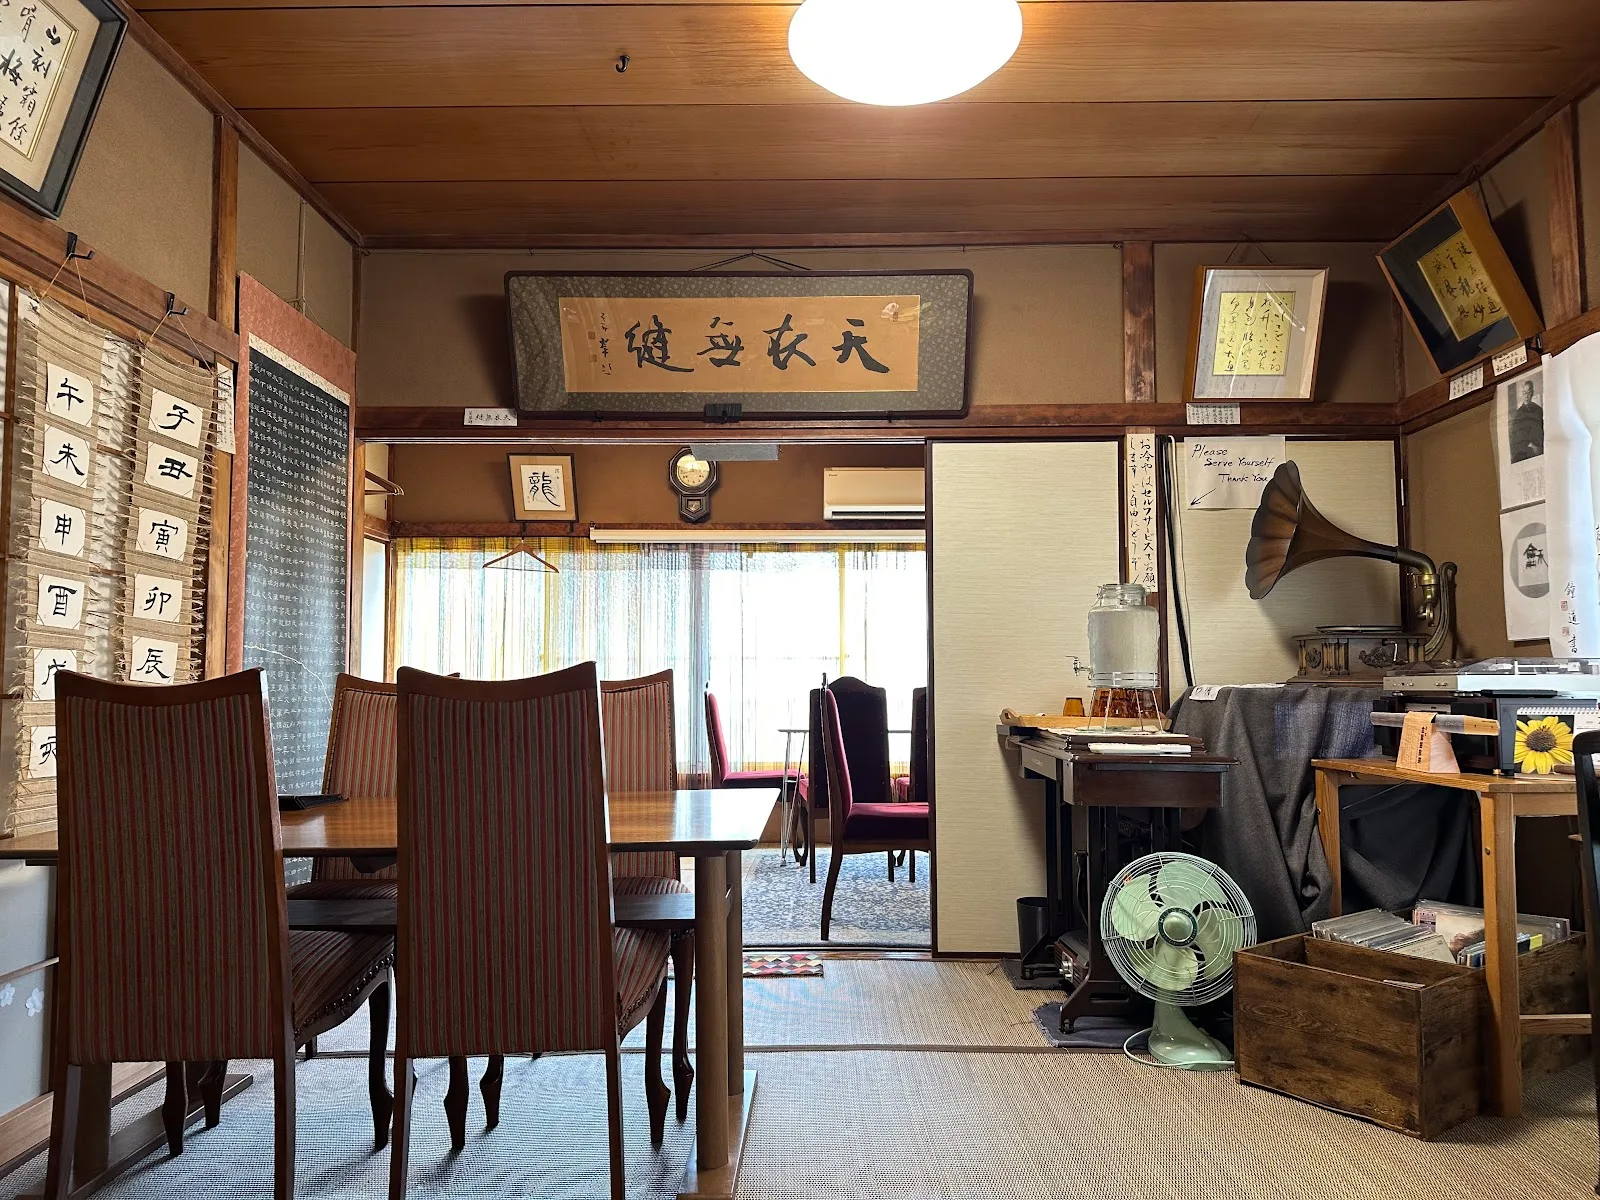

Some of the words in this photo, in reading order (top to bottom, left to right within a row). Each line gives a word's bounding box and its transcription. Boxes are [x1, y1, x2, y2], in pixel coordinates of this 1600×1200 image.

[56, 378, 84, 411] 午
[158, 404, 195, 430] 子
[50, 442, 85, 476] 未
[1192, 443, 1228, 458] Please
[1204, 458, 1233, 467] Serve
[1238, 457, 1275, 468] Yourself
[158, 457, 193, 480] 丑
[1218, 473, 1249, 483] Thank
[528, 471, 560, 507] 龍
[54, 513, 72, 546] 申
[149, 519, 179, 553] 寅
[47, 584, 77, 617] 酉
[145, 586, 172, 615] 卯
[136, 648, 171, 679] 辰
